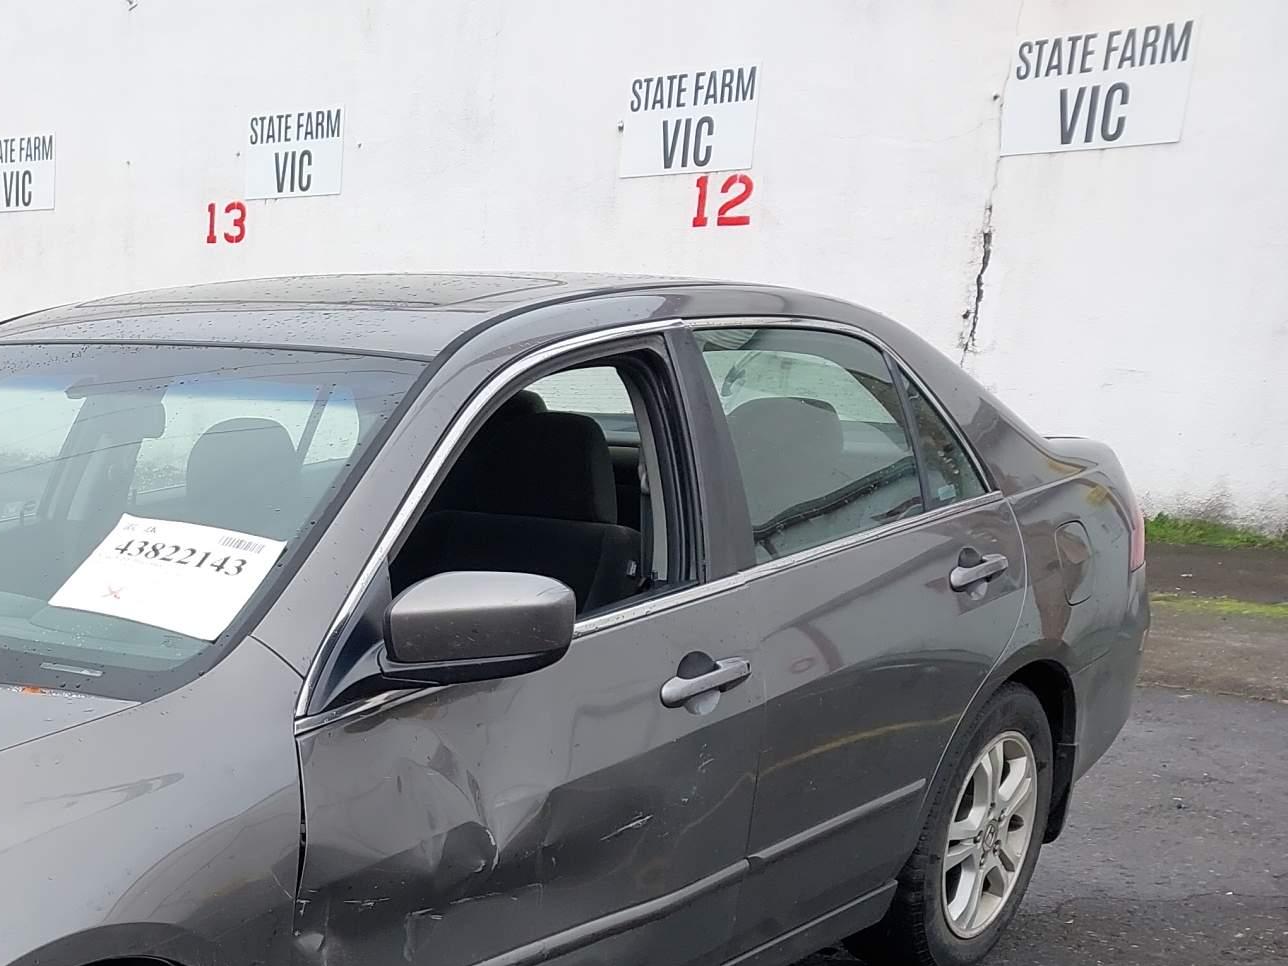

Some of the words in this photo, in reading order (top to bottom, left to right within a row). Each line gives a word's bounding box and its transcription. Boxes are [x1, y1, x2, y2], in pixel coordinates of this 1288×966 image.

[1015, 33, 1098, 81] STATE
[1102, 19, 1194, 72] FARM
[630, 73, 689, 113] STATE
[692, 65, 757, 107] FARM
[249, 113, 293, 146] STATE
[296, 108, 342, 142] FARM
[1059, 82, 1130, 146] VIC
[19, 134, 53, 163] FARM
[662, 115, 715, 170] VIC
[2, 169, 32, 208] VIC
[274, 149, 313, 194] VIC
[206, 201, 246, 244] 13
[692, 173, 752, 227] 12
[115, 539, 247, 576] 43822143
